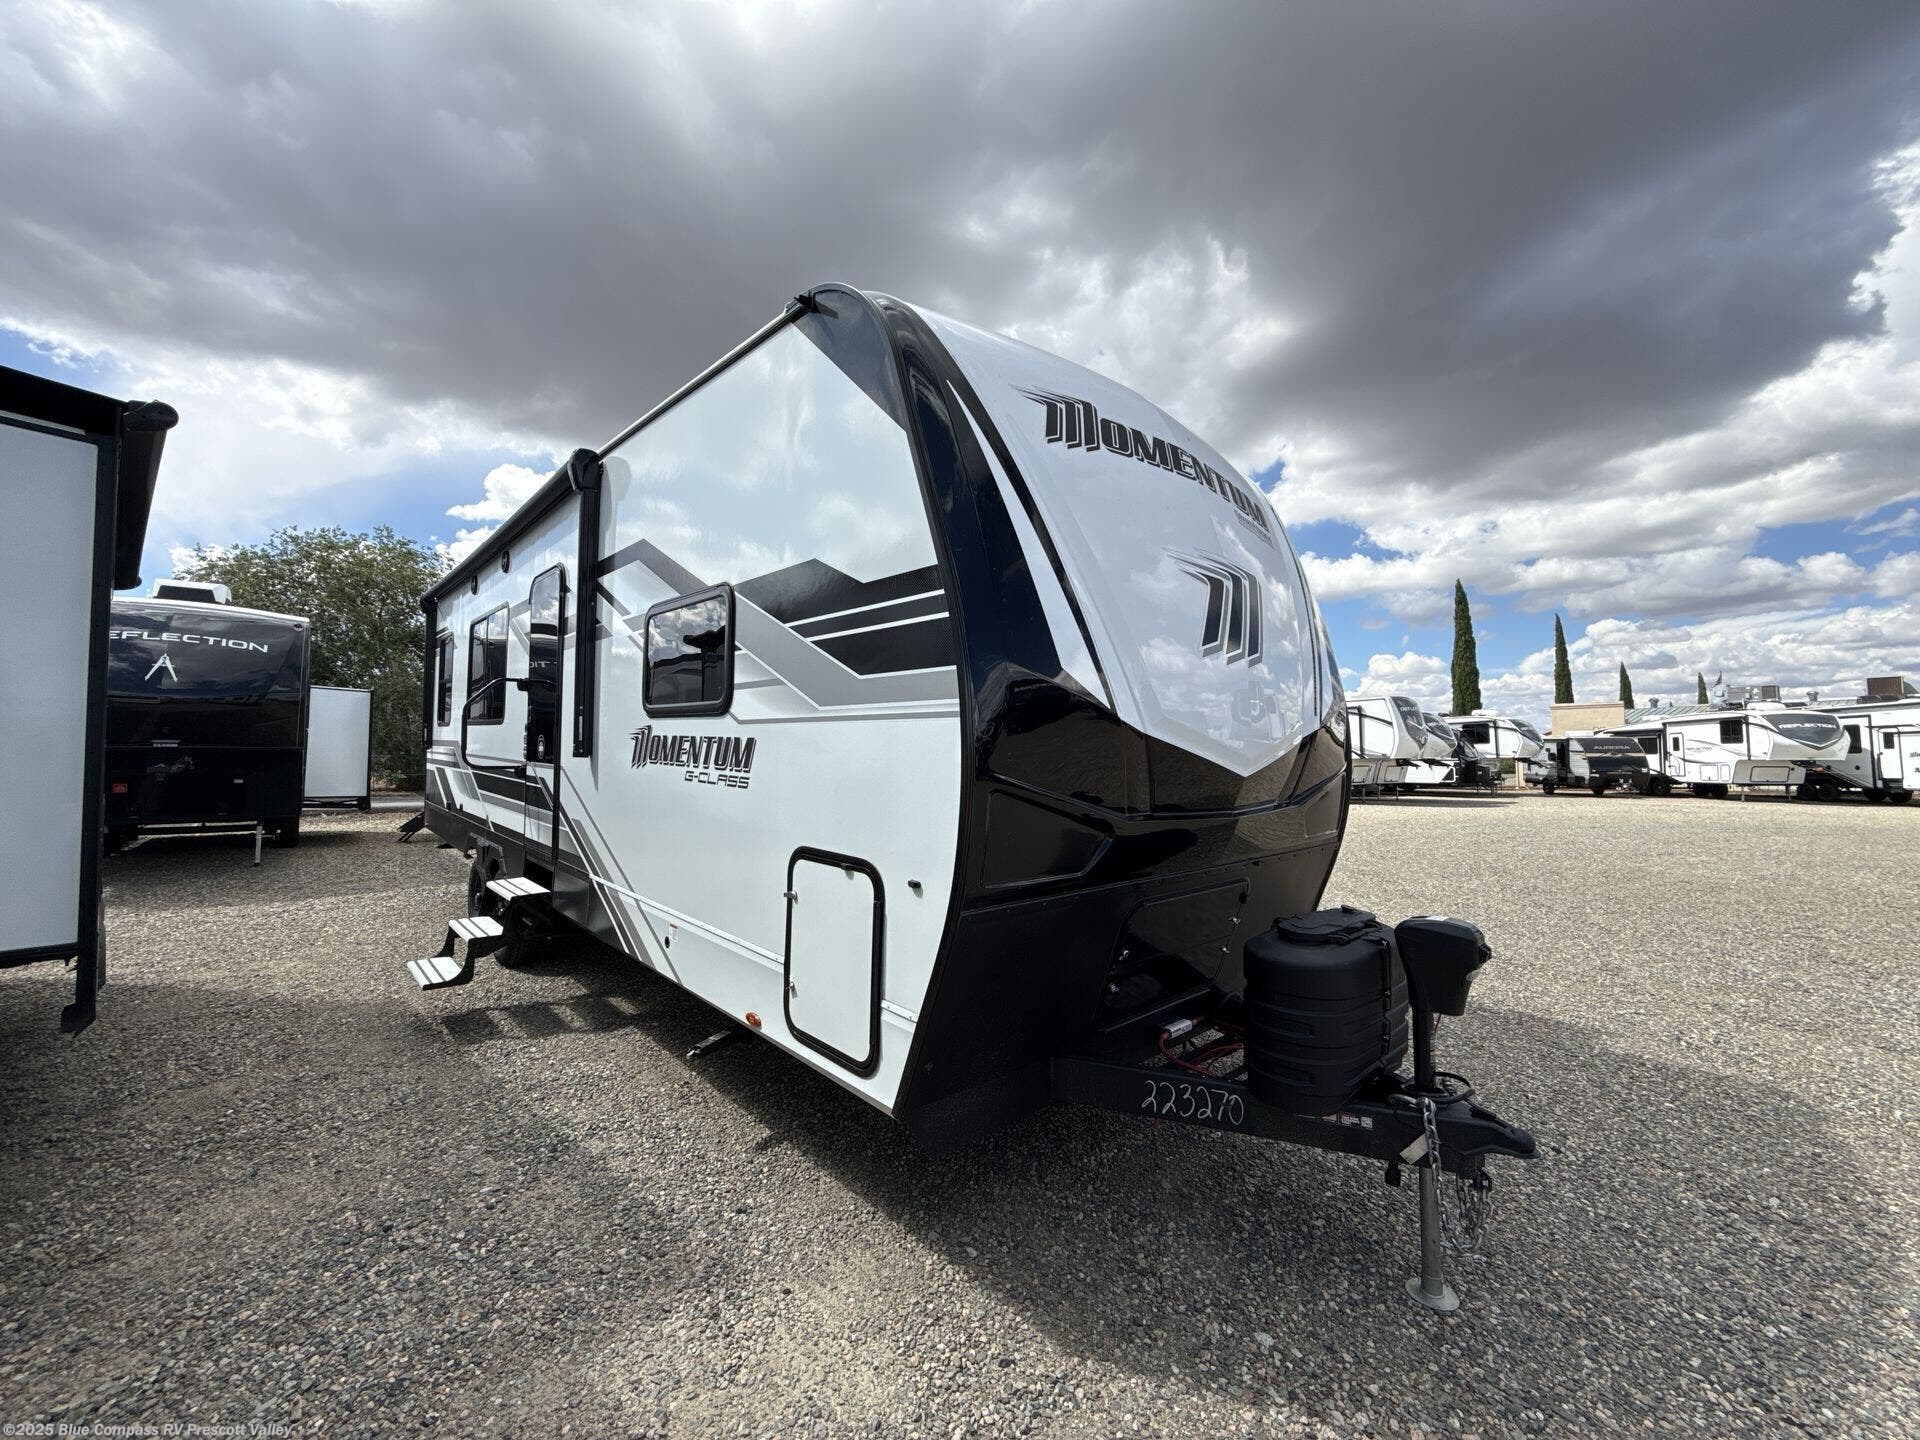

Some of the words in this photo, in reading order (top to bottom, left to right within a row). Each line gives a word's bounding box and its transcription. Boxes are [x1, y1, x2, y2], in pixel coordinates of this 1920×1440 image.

[1008, 384, 1270, 533] MOMENTUM
[110, 630, 269, 653] EFLECTION
[628, 725, 757, 773] MOMENTUM
[684, 770, 750, 789] G-CLASS
[1141, 1080, 1244, 1125] 223270
